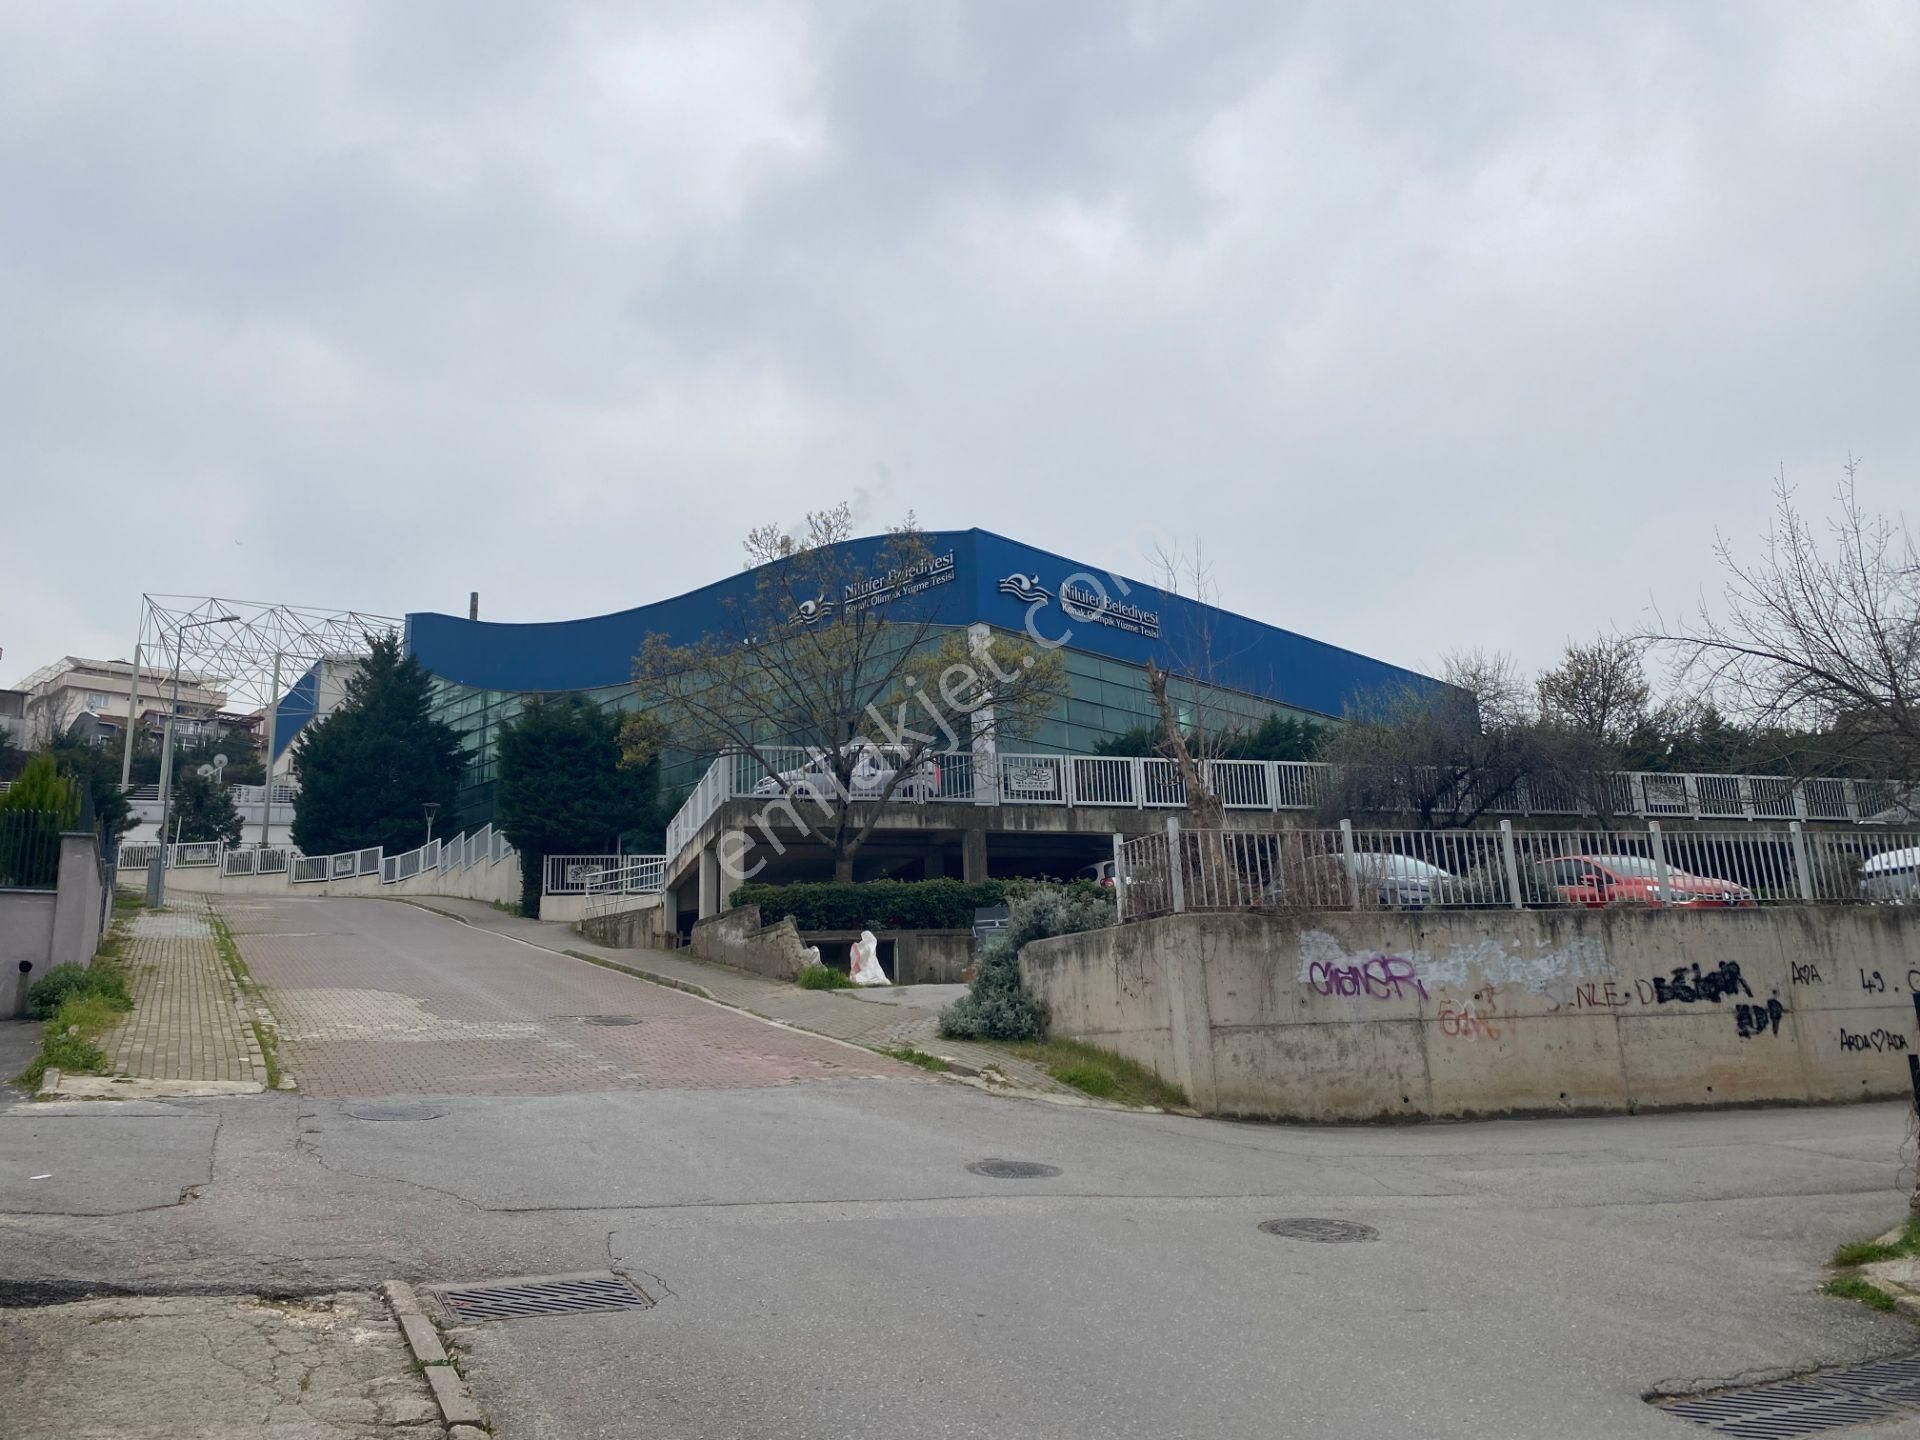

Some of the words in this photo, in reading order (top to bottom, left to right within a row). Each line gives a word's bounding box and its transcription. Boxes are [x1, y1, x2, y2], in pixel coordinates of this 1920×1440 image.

[930, 569, 955, 586] Tesisi
[1062, 582, 1100, 606] Nilüfer
[1103, 595, 1158, 624] Belediyesi
[1115, 618, 1139, 634] Yüzme
[1140, 625, 1159, 639] Tesisi
